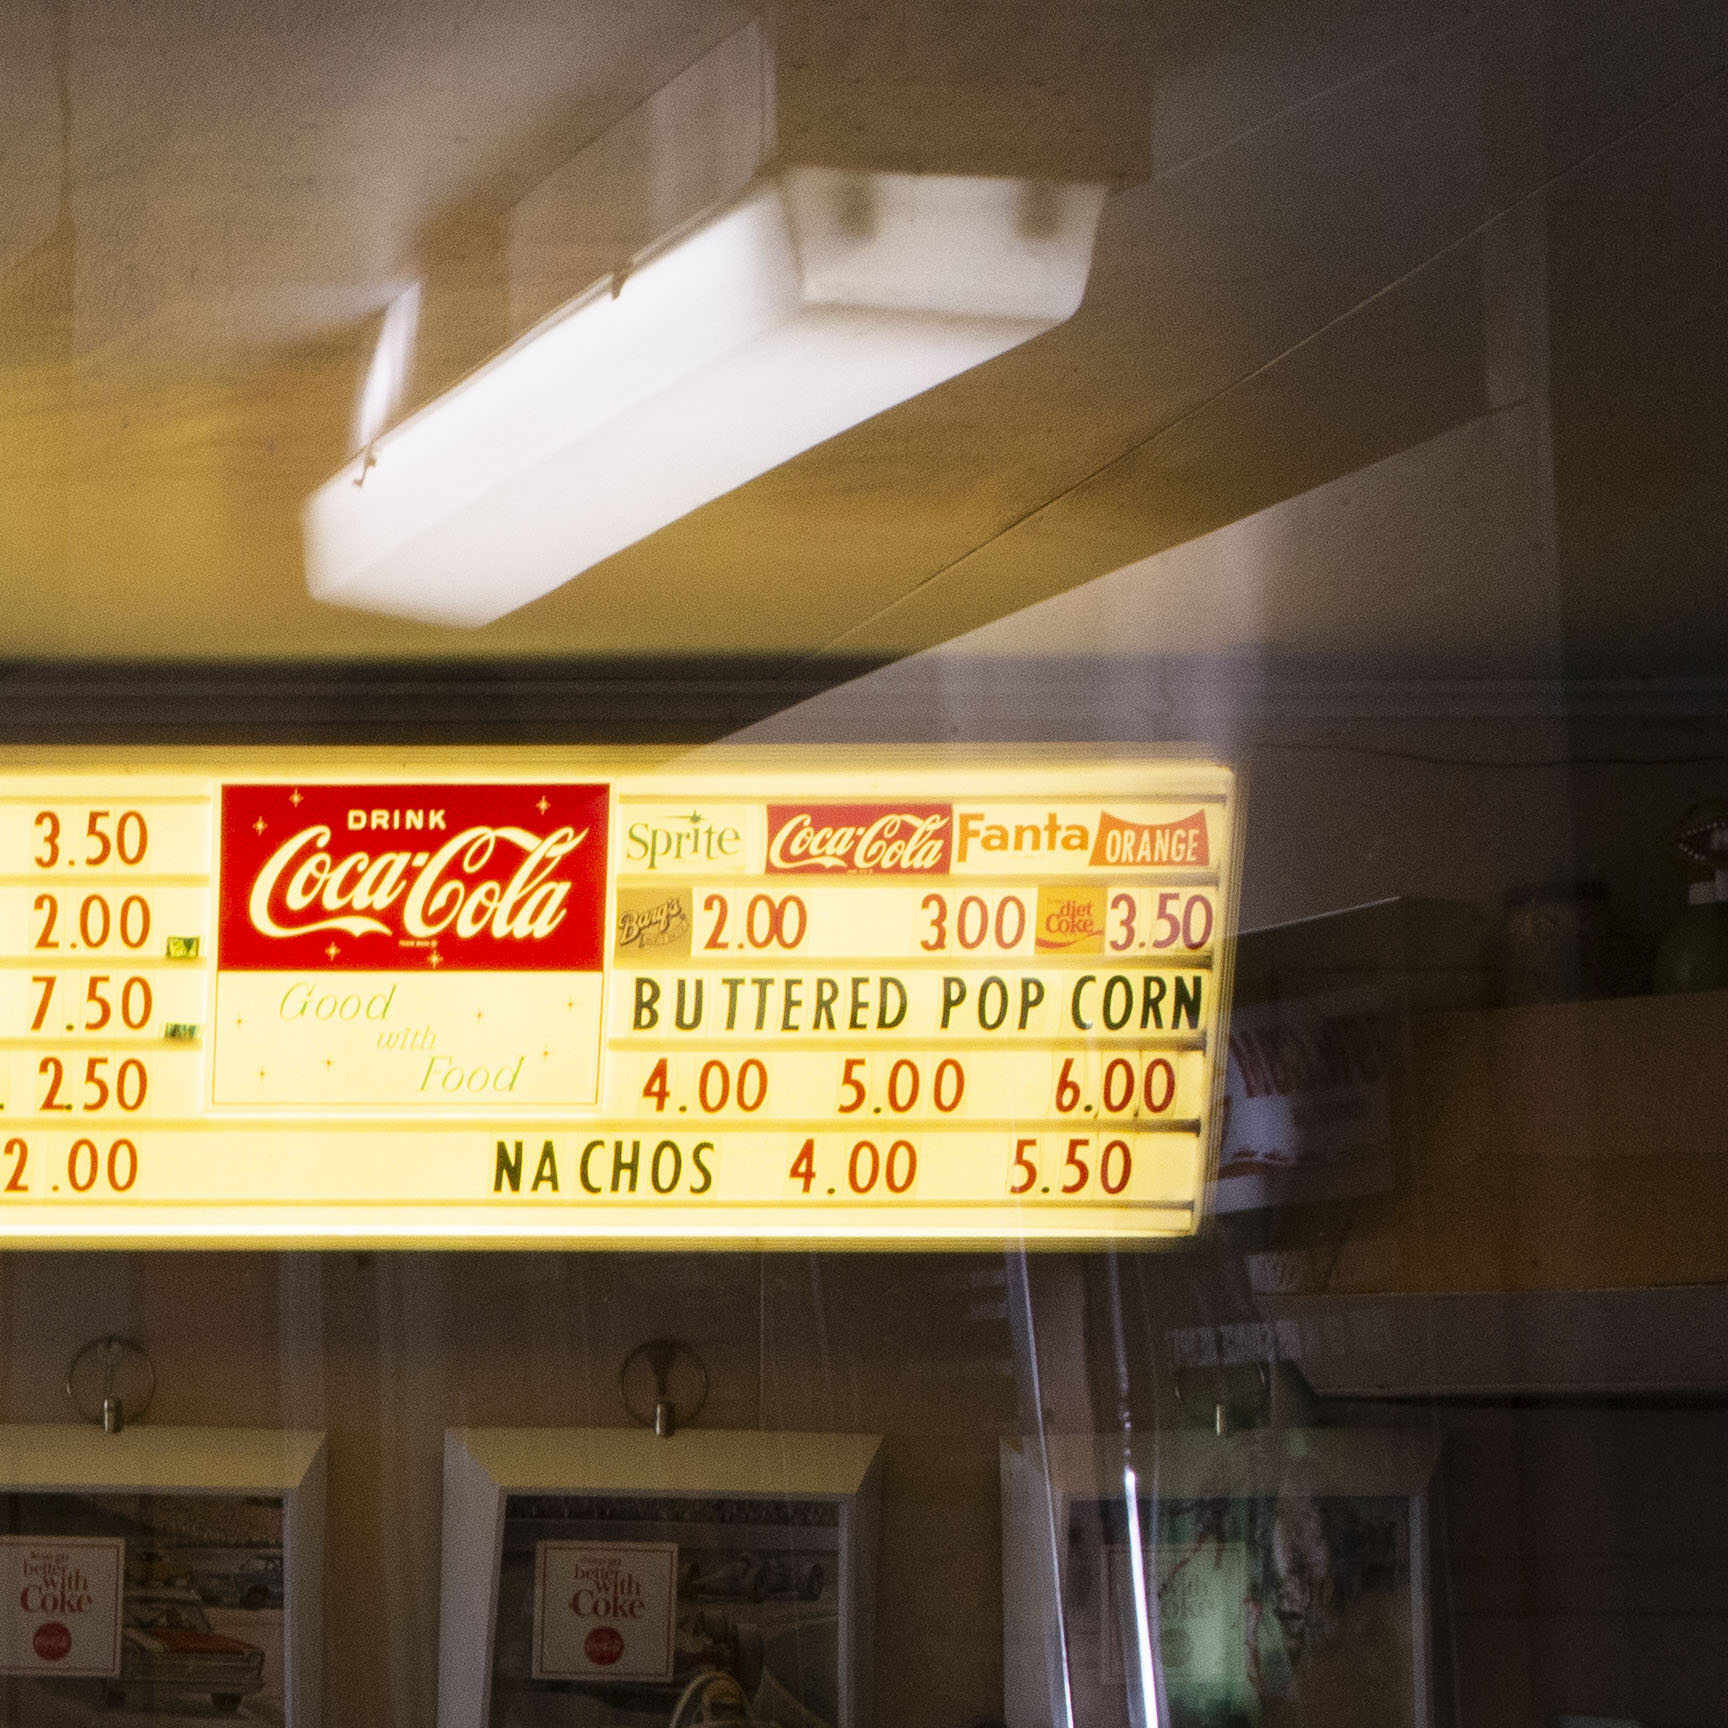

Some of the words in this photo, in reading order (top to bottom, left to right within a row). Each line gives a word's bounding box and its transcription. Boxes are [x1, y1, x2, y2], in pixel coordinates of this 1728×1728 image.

[34, 810, 148, 869] 3.50
[347, 809, 447, 831] DRINK
[626, 820, 741, 870] Sprite
[769, 814, 950, 869] Coca-Cola
[957, 812, 1089, 863] Fanta
[1105, 828, 1200, 863] ORANGE
[248, 825, 590, 940] Coca-Cola
[1060, 900, 1092, 916] diet
[34, 893, 151, 951] 2.00
[703, 894, 807, 949] 2.00
[1045, 913, 1095, 935] Coke
[1110, 893, 1214, 951] 3.50
[31, 975, 152, 1031] 7.50
[279, 982, 397, 1022] Good
[633, 976, 908, 1031] BUTTERED
[940, 975, 1046, 1031] POP
[1071, 975, 1202, 1031] CORN
[377, 1025, 437, 1051] with
[38, 1056, 148, 1112] 2.50
[419, 1055, 525, 1093] Food
[642, 1058, 769, 1113] 4.00
[838, 1058, 965, 1113] 5.00
[1055, 1058, 1176, 1113] 6.00
[4, 1138, 139, 1193] 2.00
[494, 1140, 715, 1195] NACHOS
[789, 1138, 918, 1194] 4.00
[1009, 1138, 1133, 1195] 5.50
[19, 1583, 93, 1614] Coke
[570, 1588, 646, 1619] Coke
